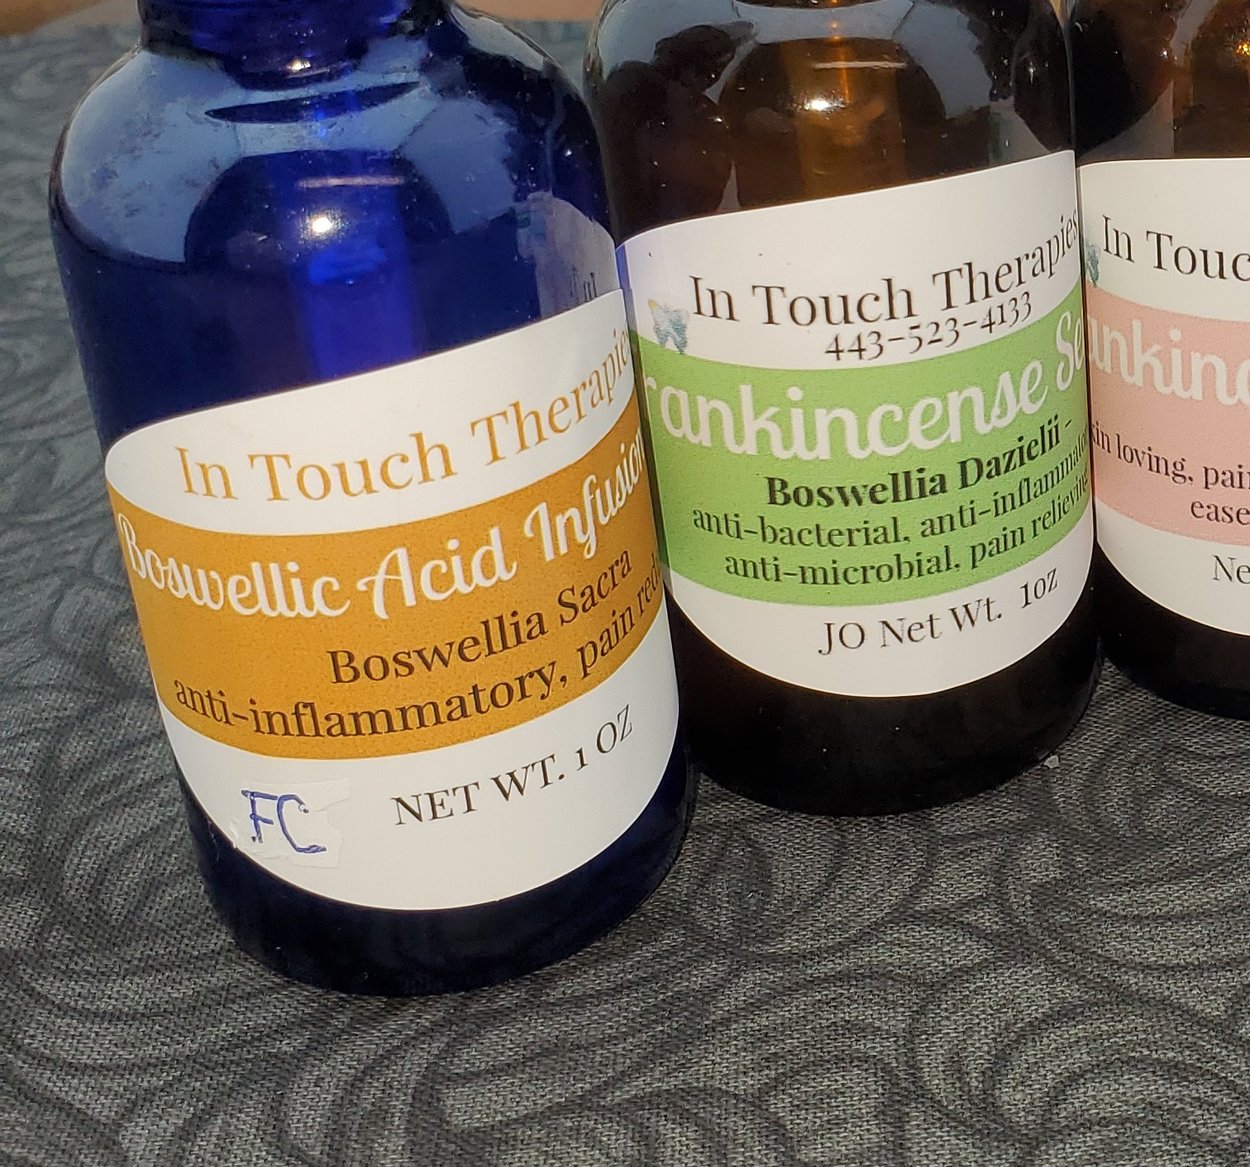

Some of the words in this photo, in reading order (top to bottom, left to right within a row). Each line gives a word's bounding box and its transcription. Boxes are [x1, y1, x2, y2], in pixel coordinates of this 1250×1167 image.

[689, 275, 740, 322] In
[752, 278, 916, 328] Touch
[932, 209, 1078, 312] Therapies
[1102, 215, 1134, 263] In
[825, 293, 1034, 362] 443-523-4133
[176, 447, 238, 499] In
[248, 432, 457, 501] Touch
[470, 328, 629, 465] Therapie
[766, 470, 948, 509] Boswellia
[958, 415, 1062, 501] Dazielii
[1117, 432, 1194, 487] loving,
[693, 508, 911, 549] anti-bacterial,
[920, 425, 1088, 538] anti-inflammato
[119, 513, 351, 618] Boswellic
[357, 528, 516, 619] Acid
[725, 547, 961, 586] anti-microbial,
[970, 527, 1026, 569] pain
[174, 660, 567, 738] anti-inflammatory,
[576, 608, 635, 687] pain
[637, 552, 661, 617] red
[327, 608, 549, 684] Boswellia
[557, 547, 633, 627] Sacra
[818, 622, 865, 656] JO
[879, 613, 942, 650] Net
[950, 599, 1002, 635] Wt.
[390, 781, 480, 826] NET
[491, 754, 566, 803] WT.
[576, 746, 590, 771] 1
[595, 704, 636, 753] OZ
[240, 788, 326, 853] FC
